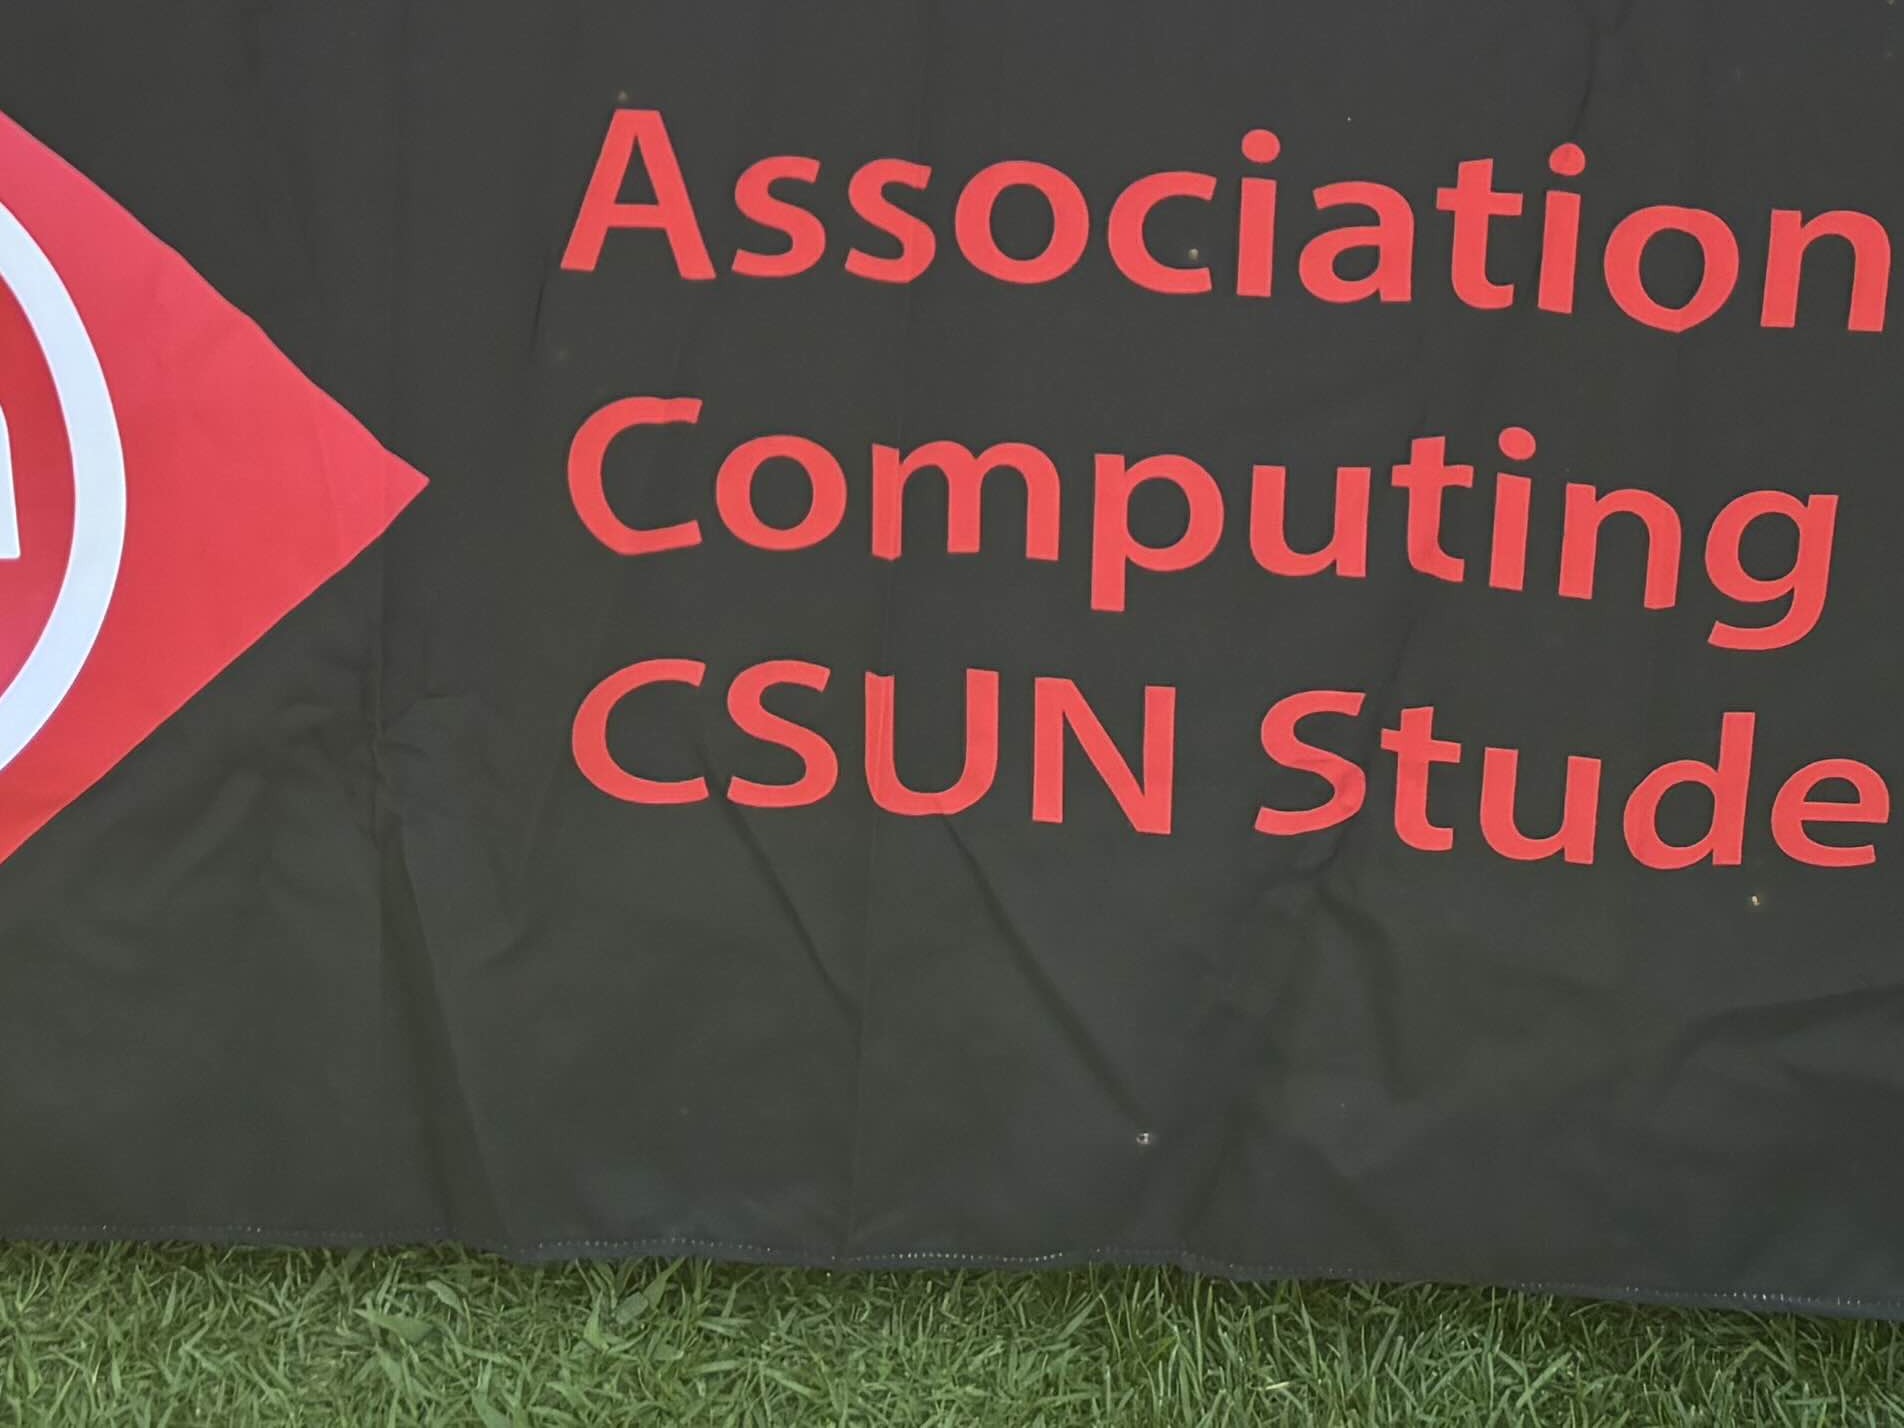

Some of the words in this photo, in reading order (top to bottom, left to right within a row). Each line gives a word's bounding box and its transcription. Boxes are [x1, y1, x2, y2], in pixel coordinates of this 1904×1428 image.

[562, 108, 1893, 335] Association
[565, 396, 1841, 652] Computing
[572, 658, 1180, 837] CSUN
